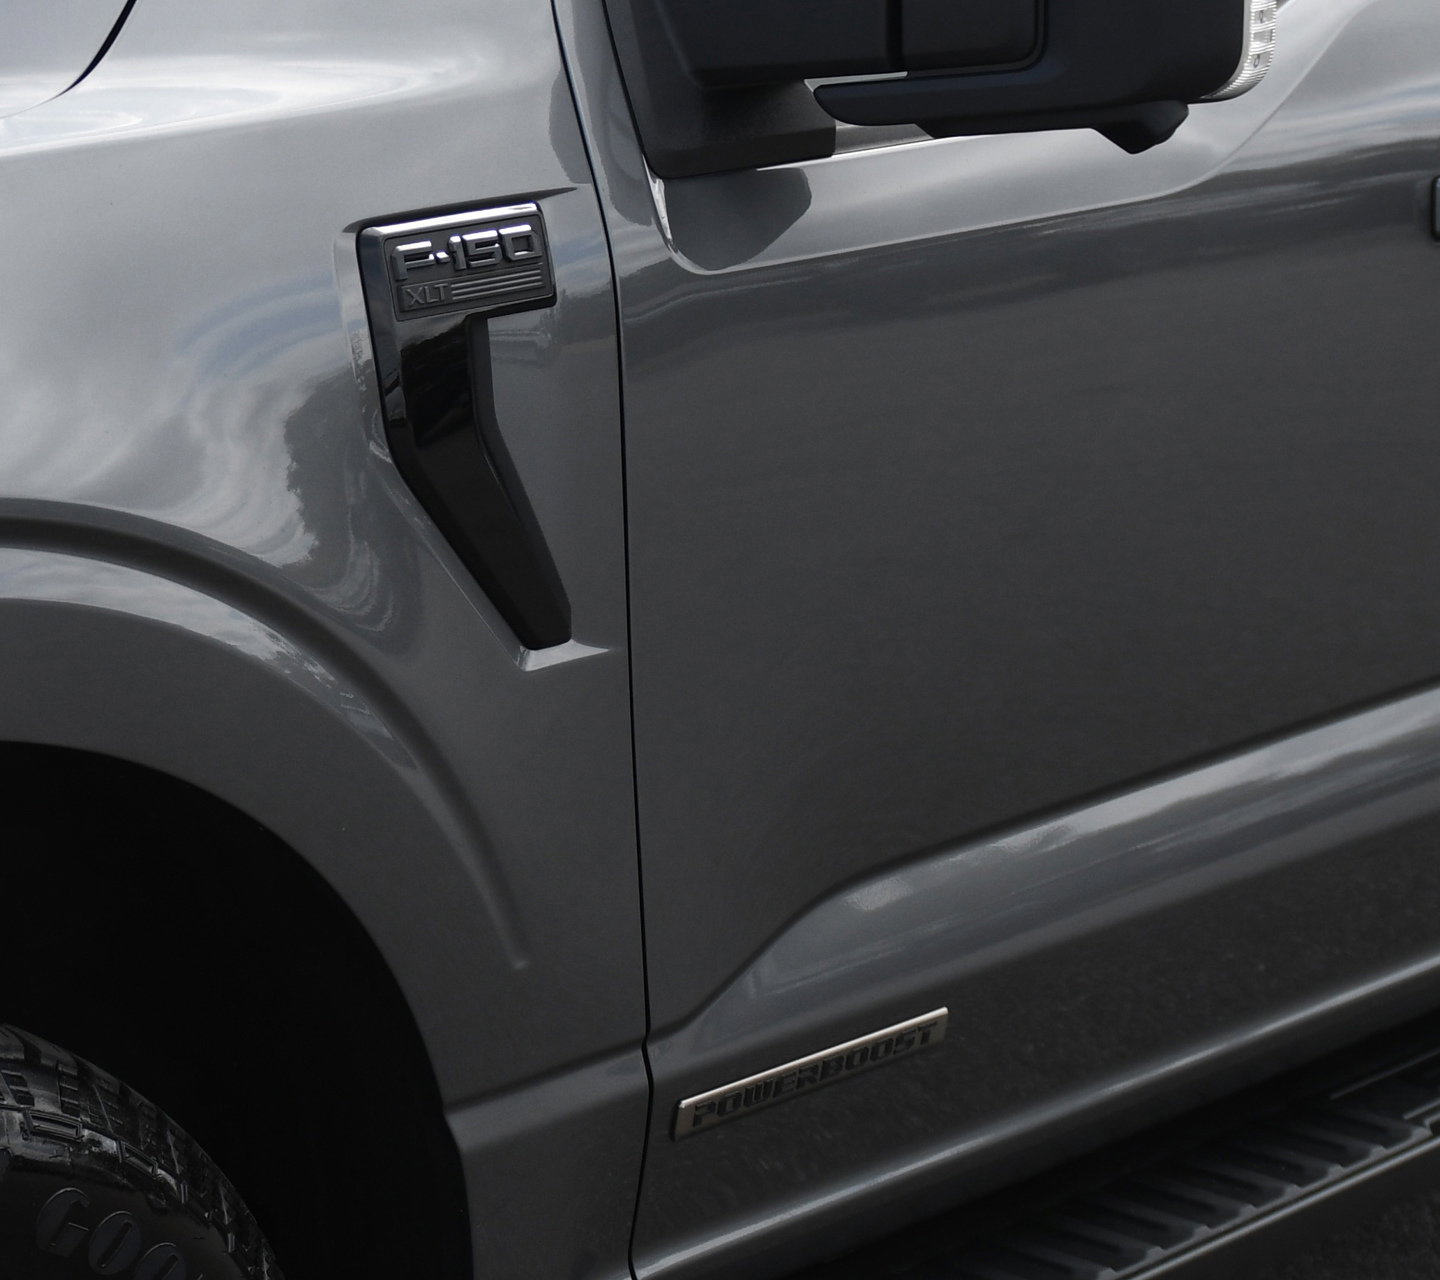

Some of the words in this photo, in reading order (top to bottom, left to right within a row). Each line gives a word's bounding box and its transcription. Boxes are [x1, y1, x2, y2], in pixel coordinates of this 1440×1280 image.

[391, 224, 544, 282] F-150
[405, 283, 449, 306] XLT
[692, 1021, 939, 1128] POWERBOOST
